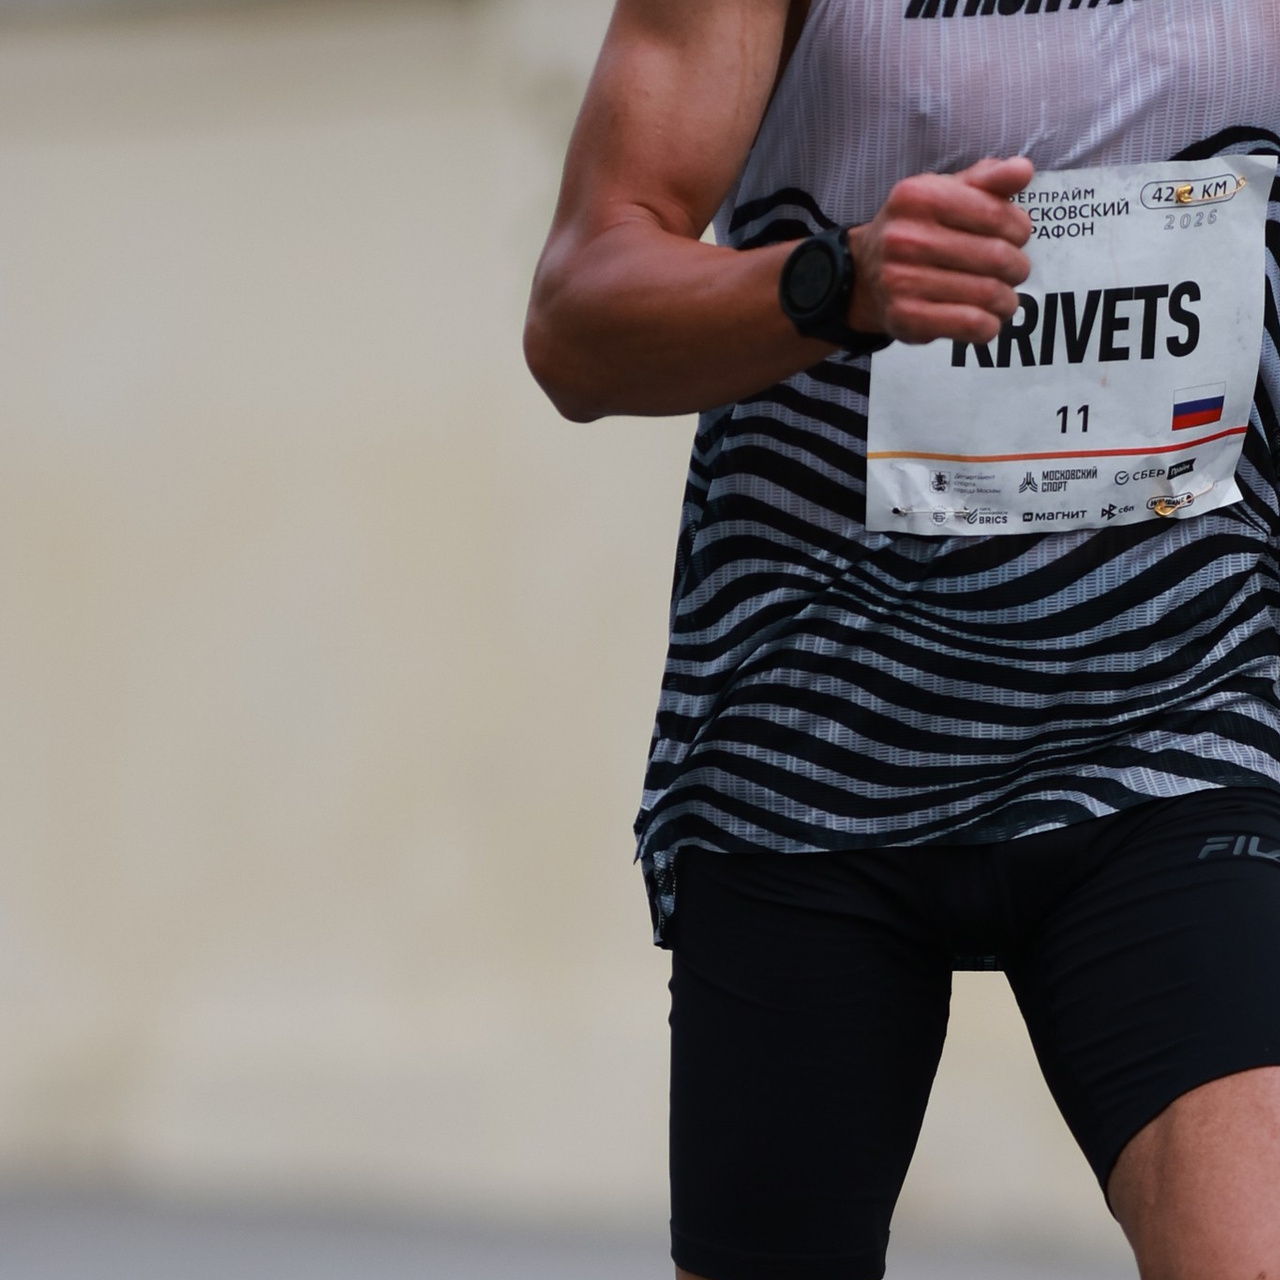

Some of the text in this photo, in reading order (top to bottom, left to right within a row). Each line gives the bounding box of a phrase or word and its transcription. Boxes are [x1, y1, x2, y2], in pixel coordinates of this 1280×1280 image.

[1008, 188, 1096, 204] ЕРПРАЙМ
[1027, 197, 1130, 222] СКОВСКИЙ
[1163, 209, 1219, 231] 2026
[1030, 222, 1095, 240] АФОН
[1056, 404, 1090, 434] 11
[1041, 466, 1098, 481] МОСКОВСКИЙ
[1132, 470, 1166, 482] СБЕР
[1041, 480, 1068, 493] СПОРТ
[979, 516, 1008, 524] BRICS
